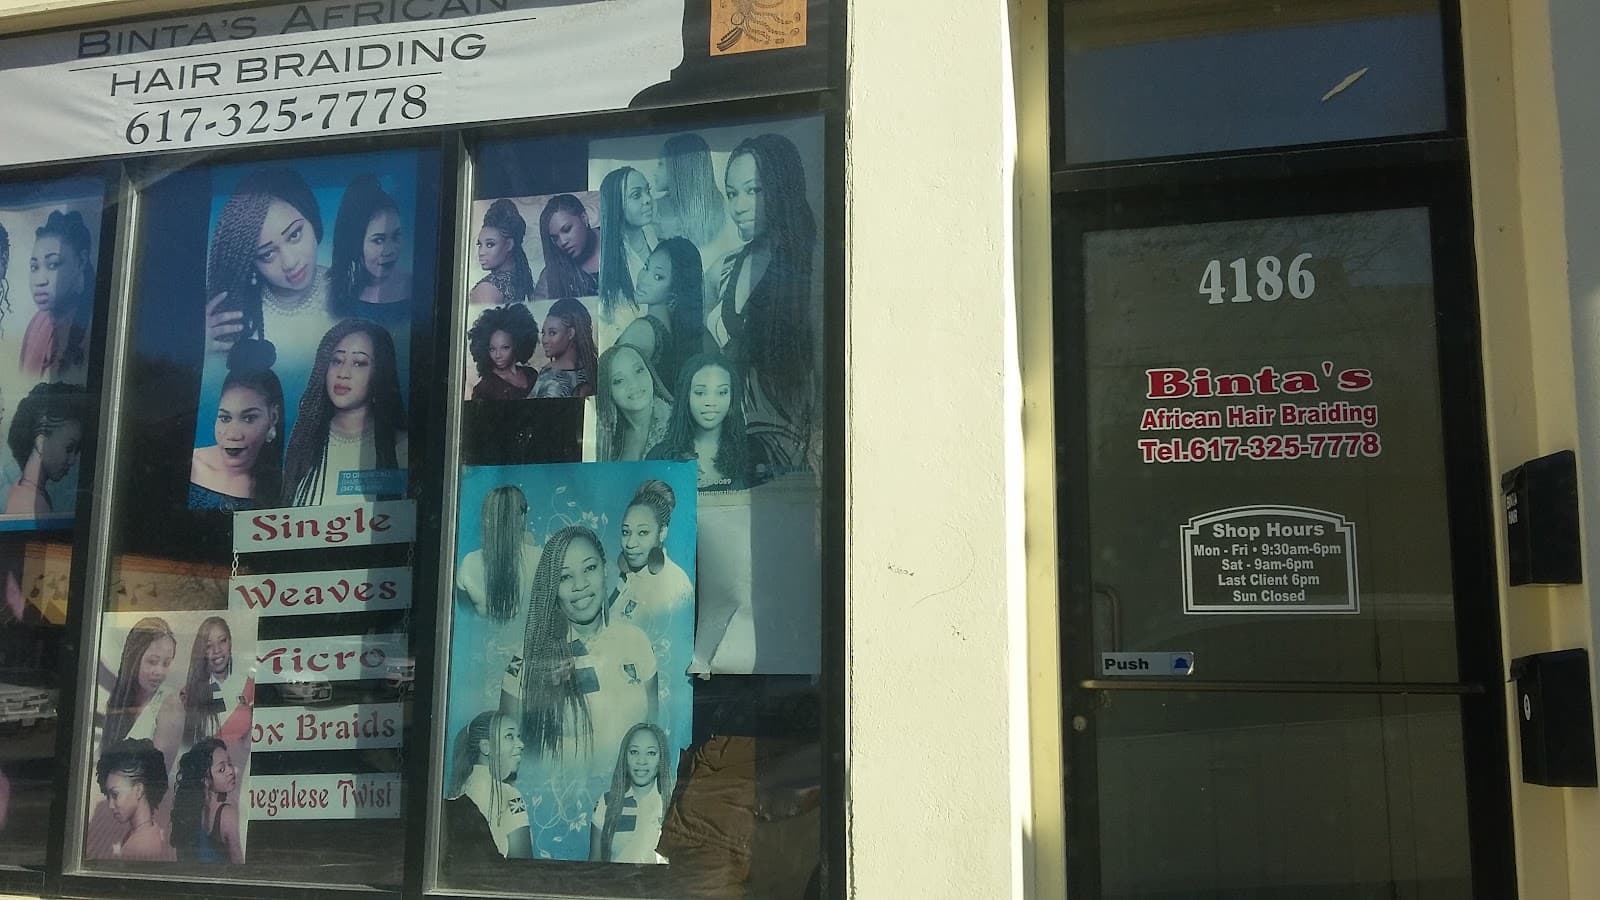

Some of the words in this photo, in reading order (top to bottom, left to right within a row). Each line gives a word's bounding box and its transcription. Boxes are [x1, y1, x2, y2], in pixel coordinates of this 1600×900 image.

[77, 16, 257, 59] BINTA'S
[110, 62, 222, 97] HAIR
[236, 33, 488, 84] BRAIDING
[125, 84, 428, 145] 617-325-7778
[1198, 252, 1316, 305] 4186
[1146, 361, 1373, 400] Binta's
[1140, 407, 1222, 431] African
[1227, 404, 1276, 428] Hair
[1280, 401, 1378, 428] Braiding
[1138, 433, 1382, 464] Tel.617-325-7778
[251, 507, 392, 543] Single
[1212, 523, 1261, 540] Shop
[1266, 522, 1325, 537] Hours
[1193, 544, 1220, 556] Mon
[1231, 543, 1249, 556] Fri
[1261, 543, 1342, 557] 9:30am-6pm
[1221, 558, 1243, 571] Sat
[1254, 558, 1314, 572] 9am-6pm
[235, 578, 398, 610] Weaves
[1218, 573, 1246, 586] Last
[1250, 573, 1288, 586] Client
[1291, 573, 1320, 588] 6pm
[1233, 590, 1257, 602] Sun
[1261, 589, 1306, 602] Closed
[1104, 658, 1150, 671] Push
[251, 722, 286, 746] ox
[296, 710, 396, 741] Braids
[336, 779, 392, 809] Twist
